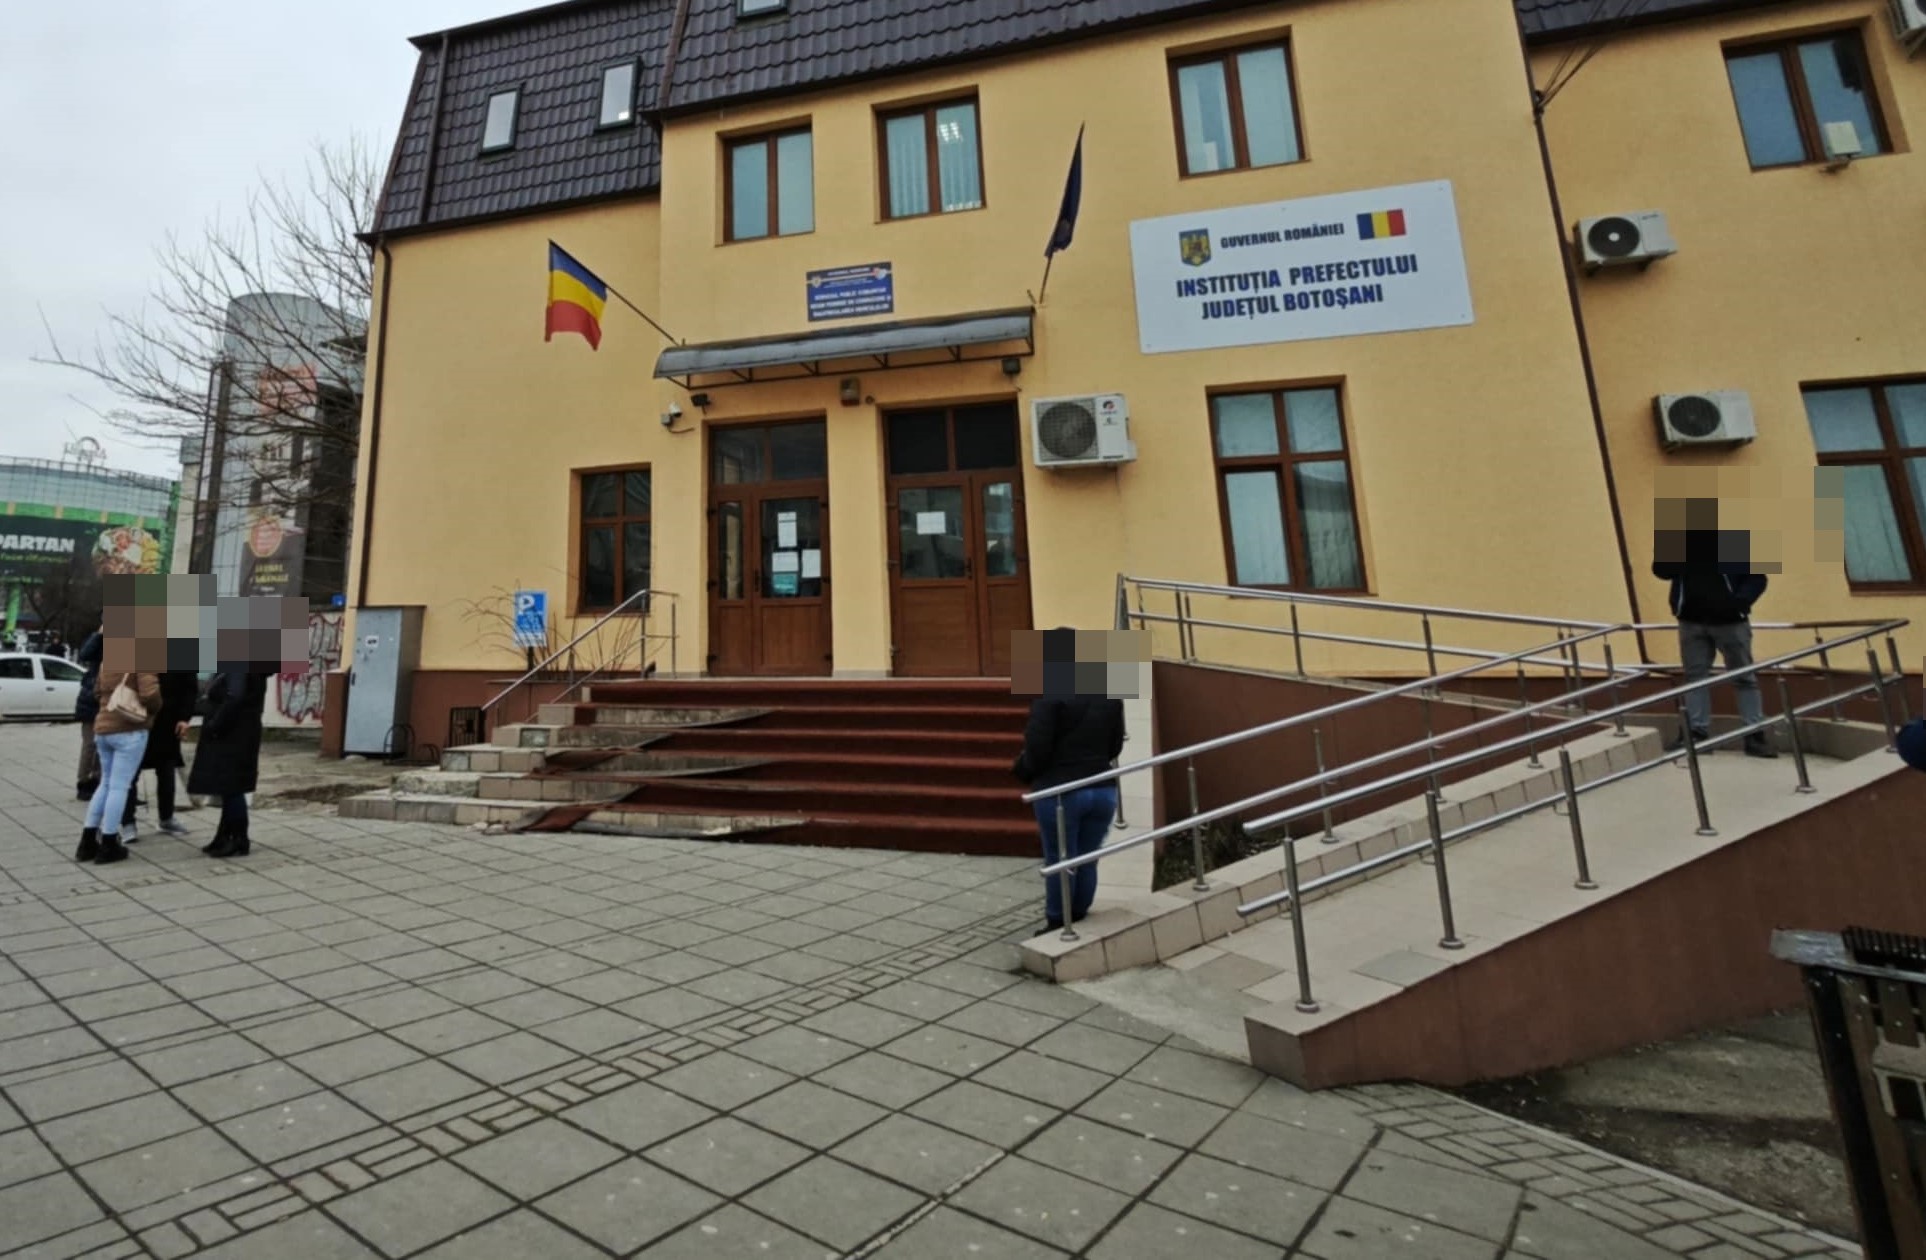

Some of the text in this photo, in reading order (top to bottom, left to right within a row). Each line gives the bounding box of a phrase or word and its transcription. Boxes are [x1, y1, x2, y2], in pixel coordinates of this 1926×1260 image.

[1220, 223, 1345, 249] GUVERNUL ROMÂNIEI
[1289, 254, 1418, 286] PREFECTULUI
